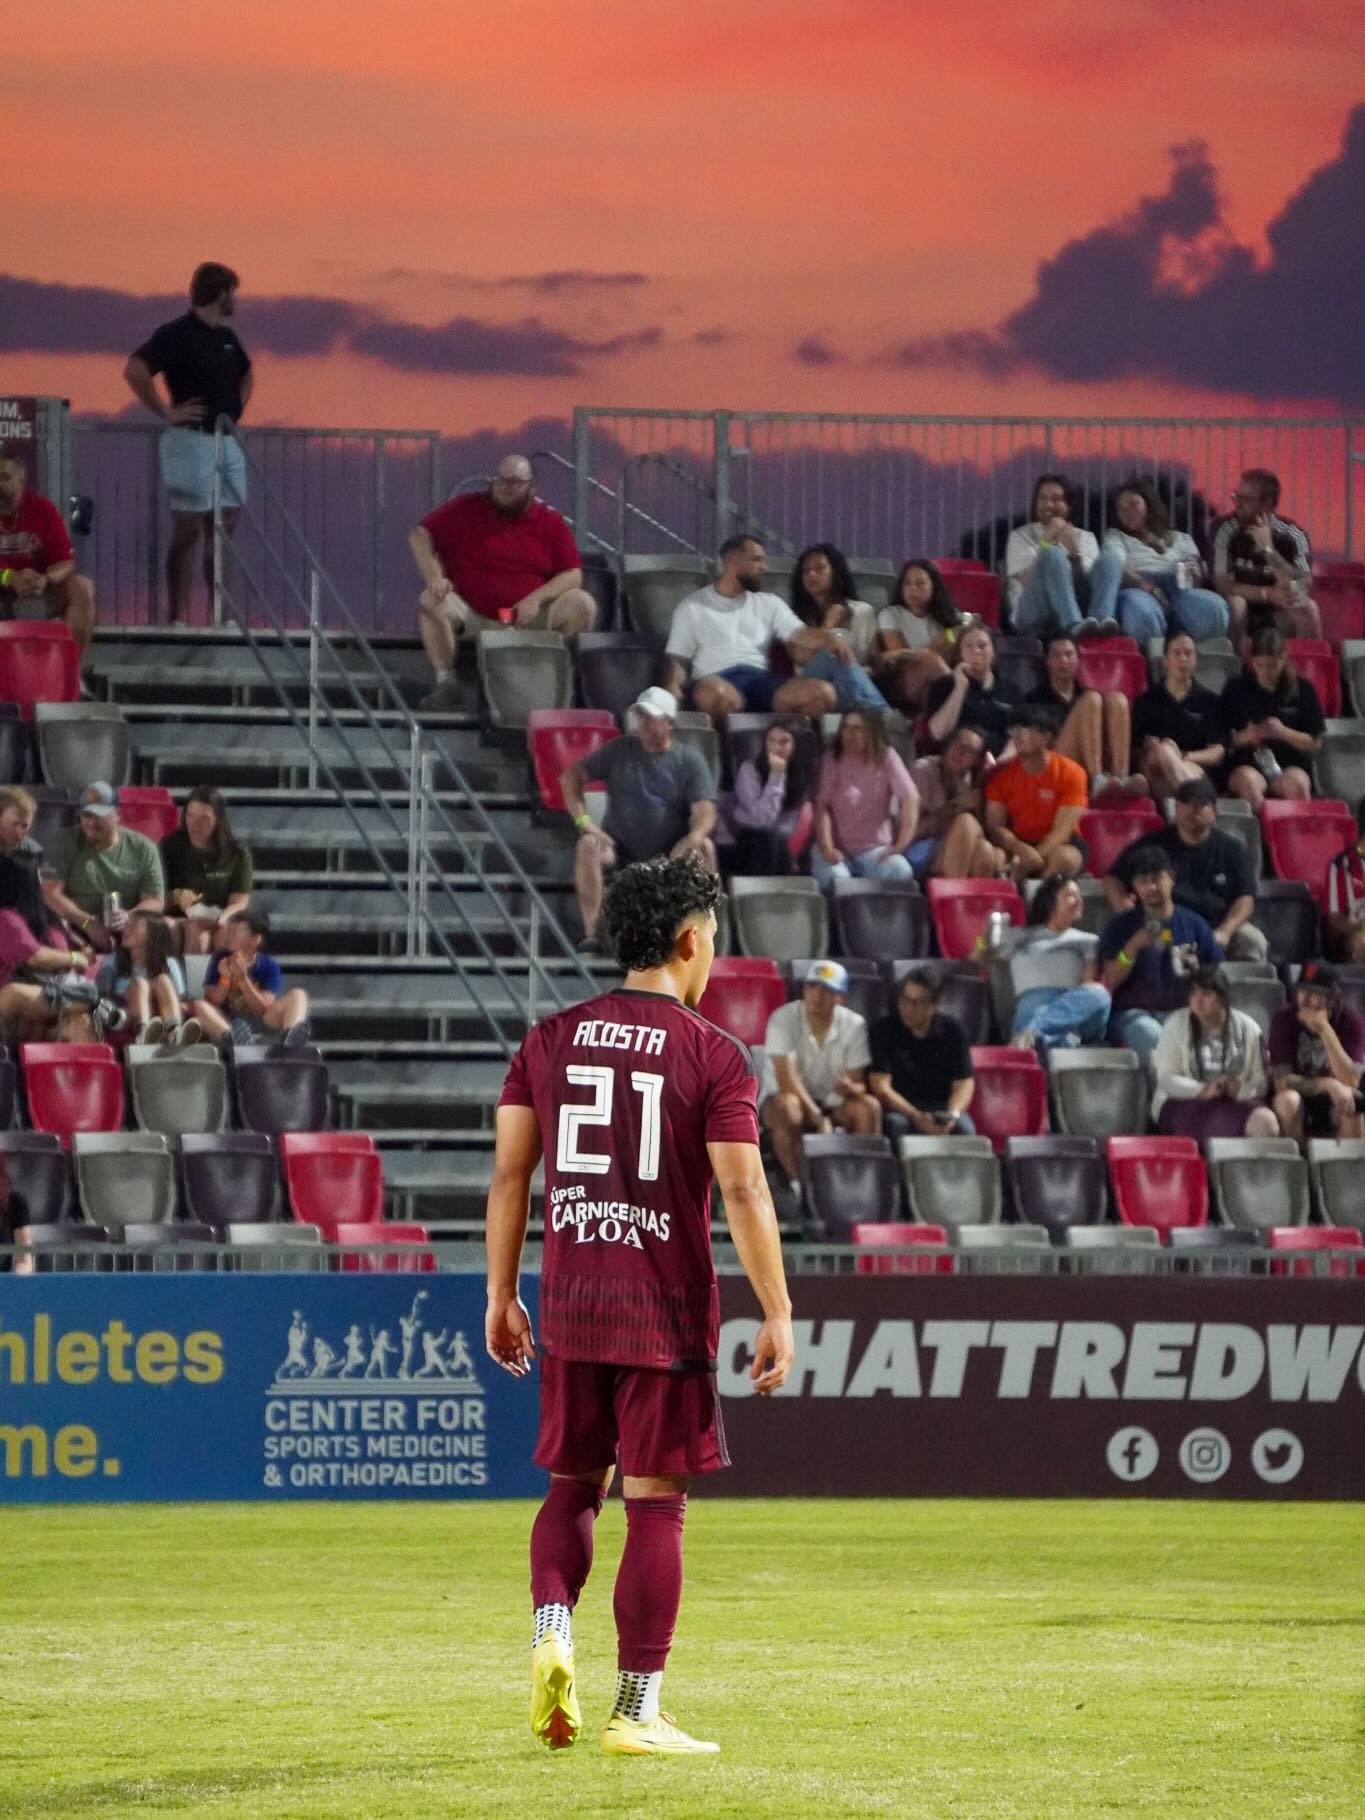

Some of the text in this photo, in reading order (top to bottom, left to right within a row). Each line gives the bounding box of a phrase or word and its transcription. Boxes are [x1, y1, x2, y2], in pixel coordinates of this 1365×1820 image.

[572, 1020, 667, 1055] ACOSTA
[556, 1064, 664, 1181] 21
[550, 1185, 586, 1205] ÚPER
[551, 1201, 671, 1242] CARNICERIAS
[575, 1218, 645, 1250] LOA
[717, 1317, 1365, 1402] CHATTREDW
[264, 1400, 486, 1431] CENTER FOR
[264, 1435, 487, 1458] SPORTS MEDICINE
[263, 1462, 487, 1487] & ORTHOPAEDICS
